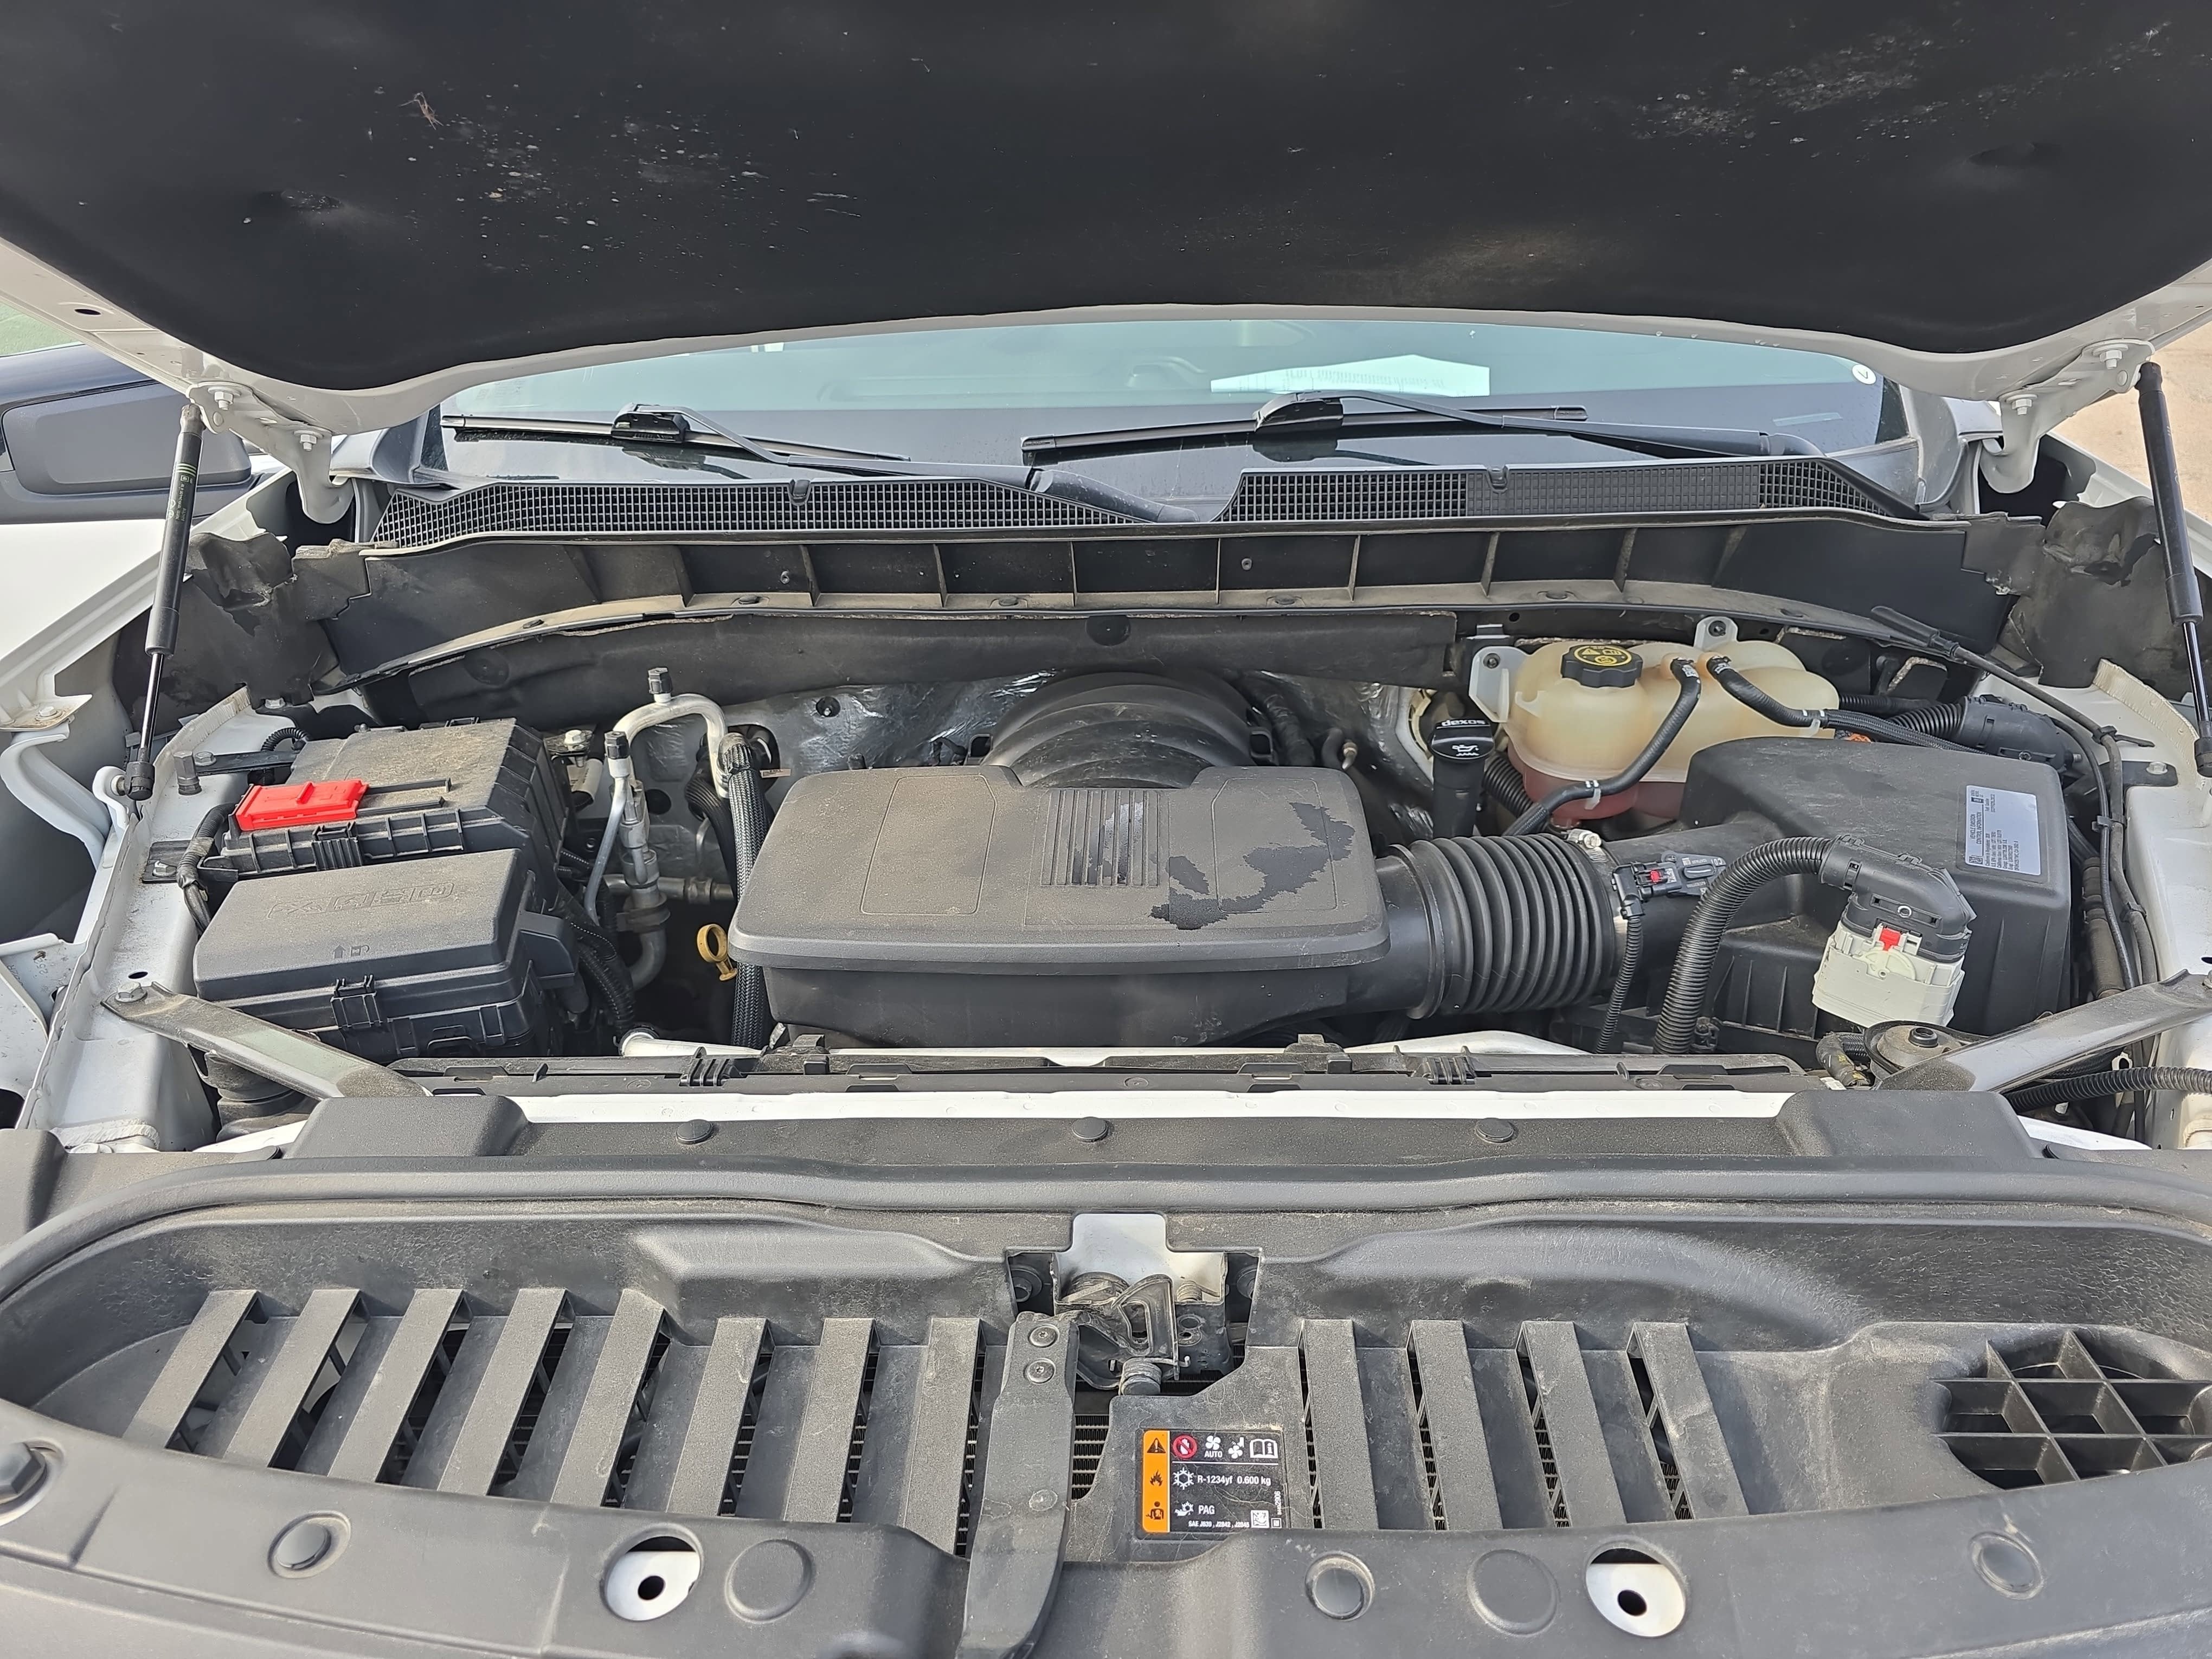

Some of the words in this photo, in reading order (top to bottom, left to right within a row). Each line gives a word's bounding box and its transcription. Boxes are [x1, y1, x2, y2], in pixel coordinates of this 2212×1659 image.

[1197, 1476, 1233, 1486] R-1234yf
[1237, 1476, 1259, 1484] 0.600
[1261, 1476, 1271, 1486] kg
[1198, 1504, 1215, 1515] PAG
